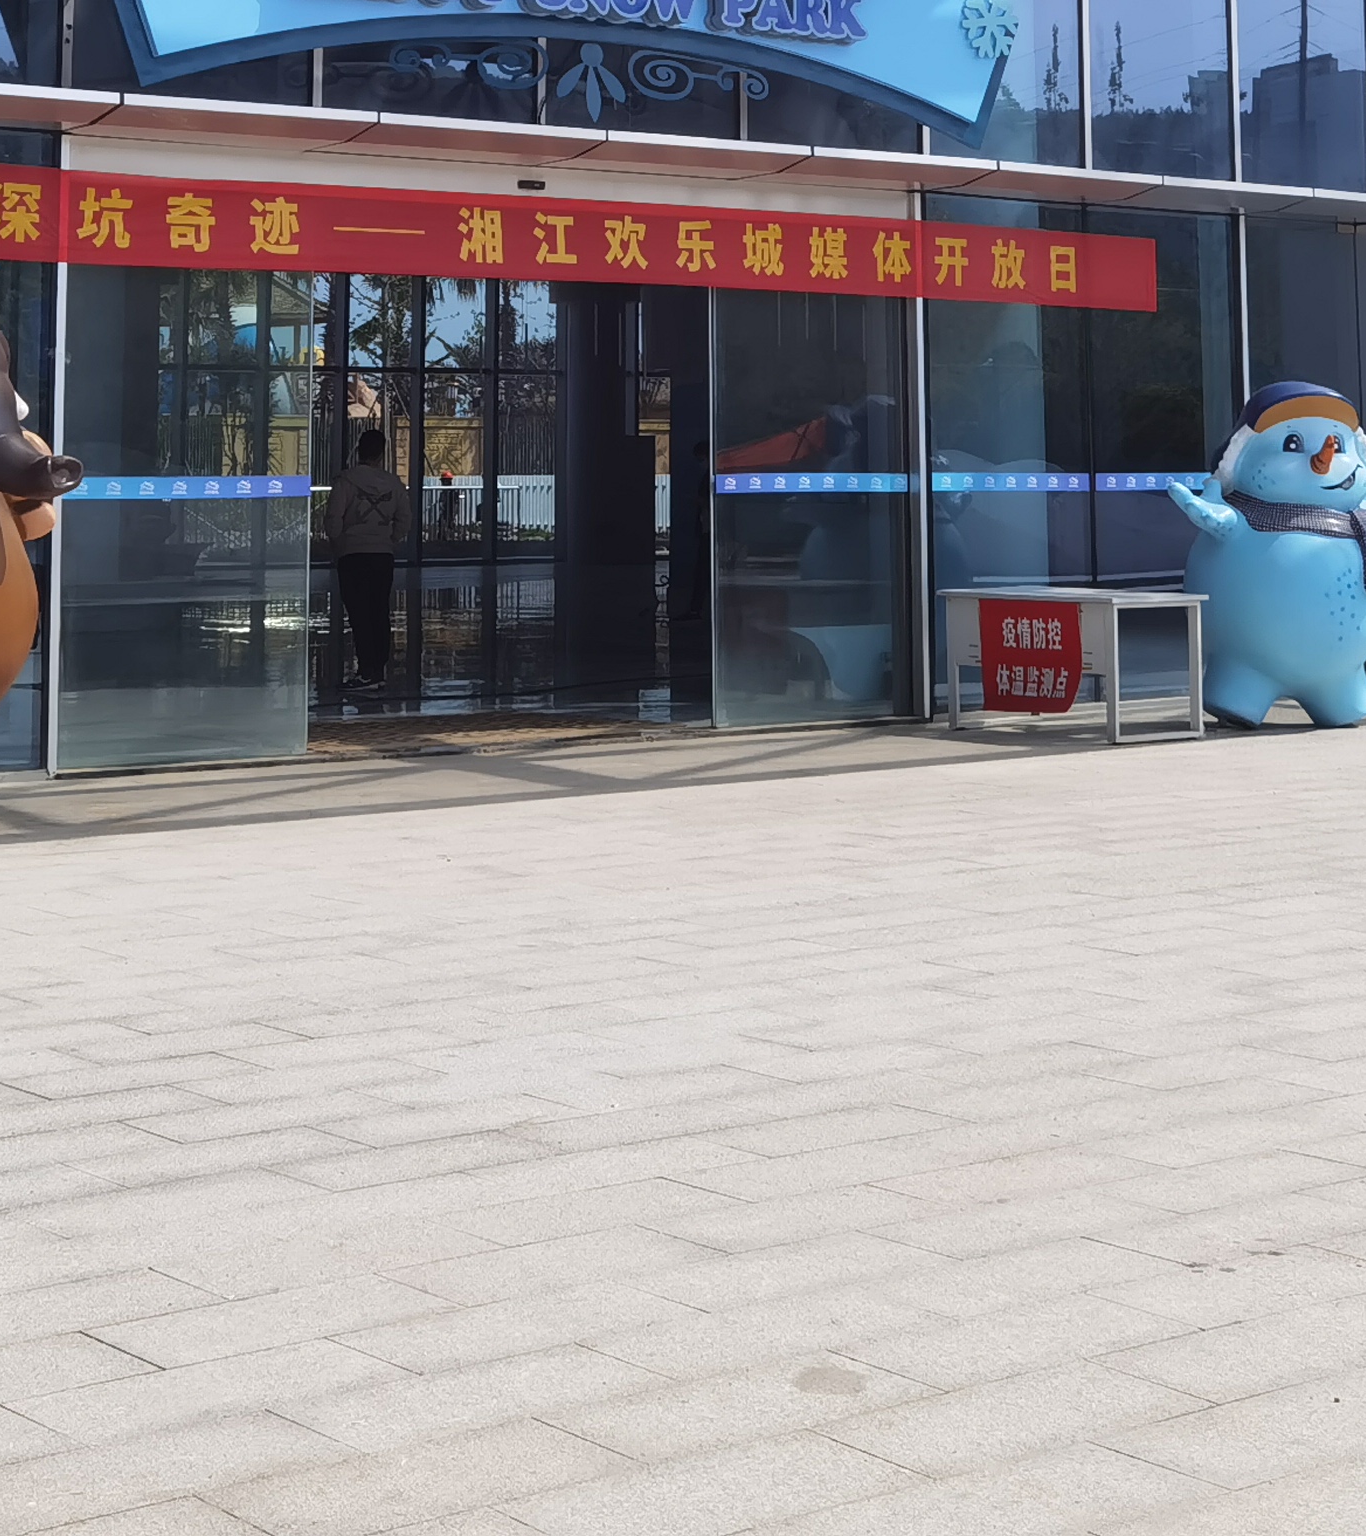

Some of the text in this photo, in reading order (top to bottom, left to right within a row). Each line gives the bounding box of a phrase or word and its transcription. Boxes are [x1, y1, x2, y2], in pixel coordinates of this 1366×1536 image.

[1001, 616, 1063, 651] 疫情防控
[995, 664, 1070, 699] 体温监测点
